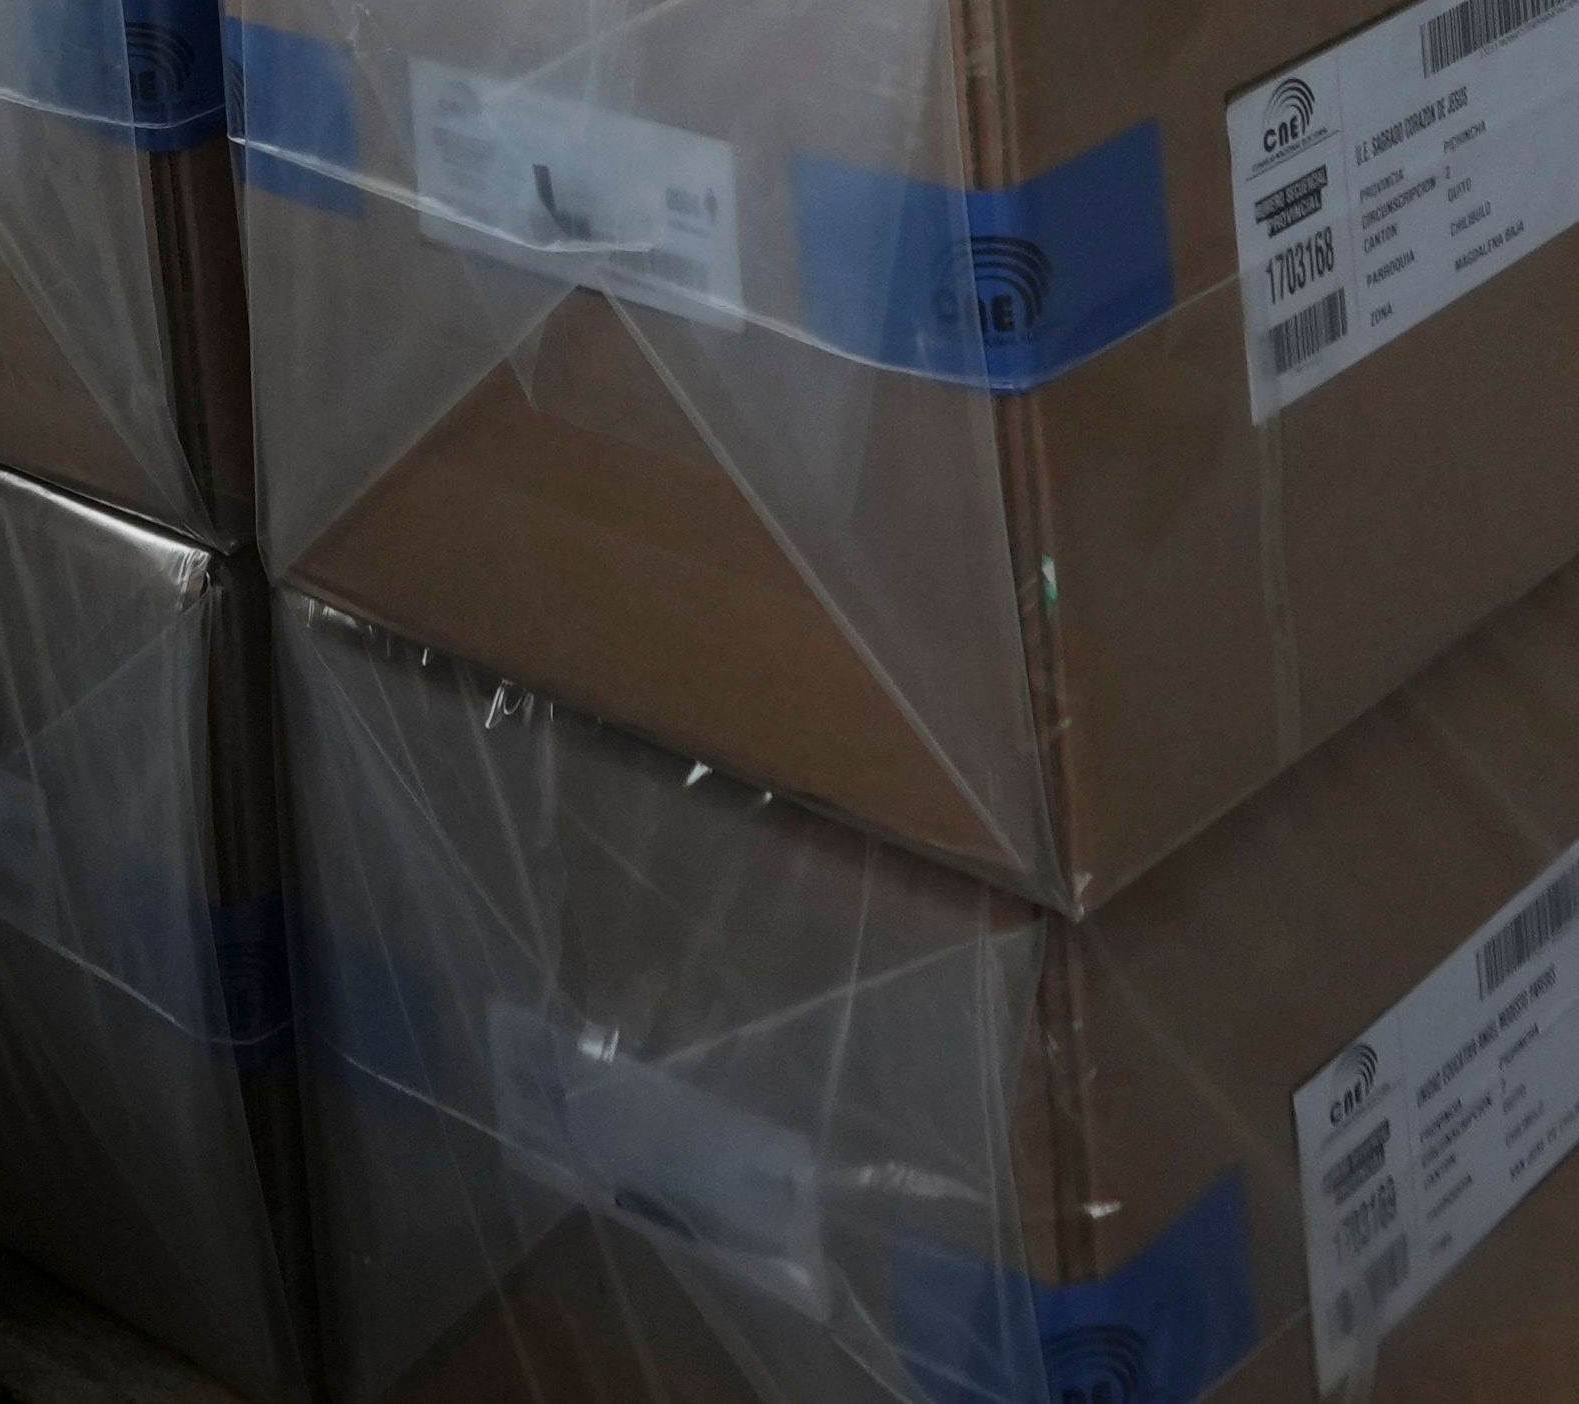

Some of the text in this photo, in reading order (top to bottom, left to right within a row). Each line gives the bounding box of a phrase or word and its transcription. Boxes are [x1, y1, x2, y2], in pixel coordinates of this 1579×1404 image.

[1263, 115, 1299, 152] CNE
[1265, 226, 1335, 304] 1703168
[1369, 302, 1393, 328] ZONA
[1330, 1080, 1362, 1127] CNE
